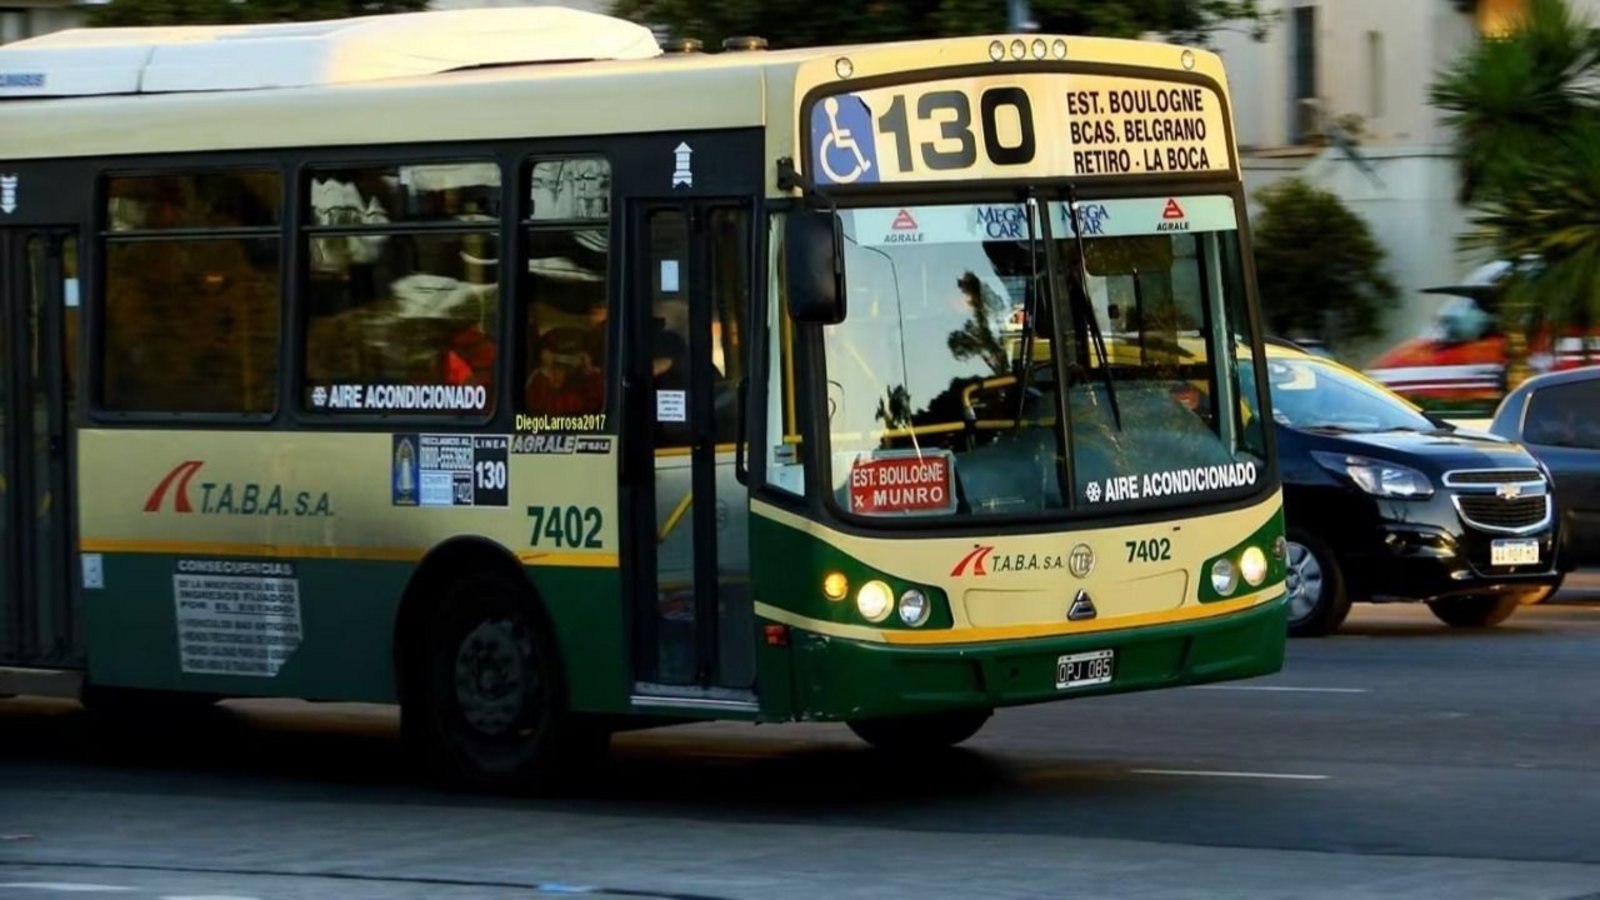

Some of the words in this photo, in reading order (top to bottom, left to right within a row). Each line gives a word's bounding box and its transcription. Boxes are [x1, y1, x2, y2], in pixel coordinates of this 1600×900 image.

[1067, 92, 1104, 115] EST.
[1109, 89, 1203, 114] BOULOGNE
[878, 87, 1036, 173] 130
[1070, 120, 1121, 144] BCAS.
[1124, 118, 1206, 142] BELGRANO
[1073, 149, 1131, 174] RETIRO
[1144, 148, 1164, 171] LA
[1167, 147, 1210, 170] BOCA
[976, 206, 1028, 224] MEGA
[1156, 222, 1190, 232] AGRALE
[884, 232, 925, 243] AGRALE
[986, 221, 1022, 239] CAR
[328, 385, 362, 409] AIRE
[365, 385, 486, 410] ACONDICIONADO
[475, 439, 507, 449] LINEA
[512, 435, 577, 454] AGRALE
[475, 460, 506, 490] 130
[852, 467, 877, 487] EST.
[879, 462, 944, 486] BOULOGNE
[1105, 476, 1139, 503] AIRE
[1142, 462, 1257, 498] ACONDICIONADO
[201, 482, 289, 516] T.A.B.A.
[295, 491, 335, 517] S.A.
[873, 486, 944, 507] MUNRO
[527, 505, 603, 549] 7402
[991, 553, 1041, 574] T.A.B.A.
[1125, 538, 1172, 564] 7402
[178, 560, 293, 575] CONSECUENCIAS
[1088, 658, 1111, 678] 085
